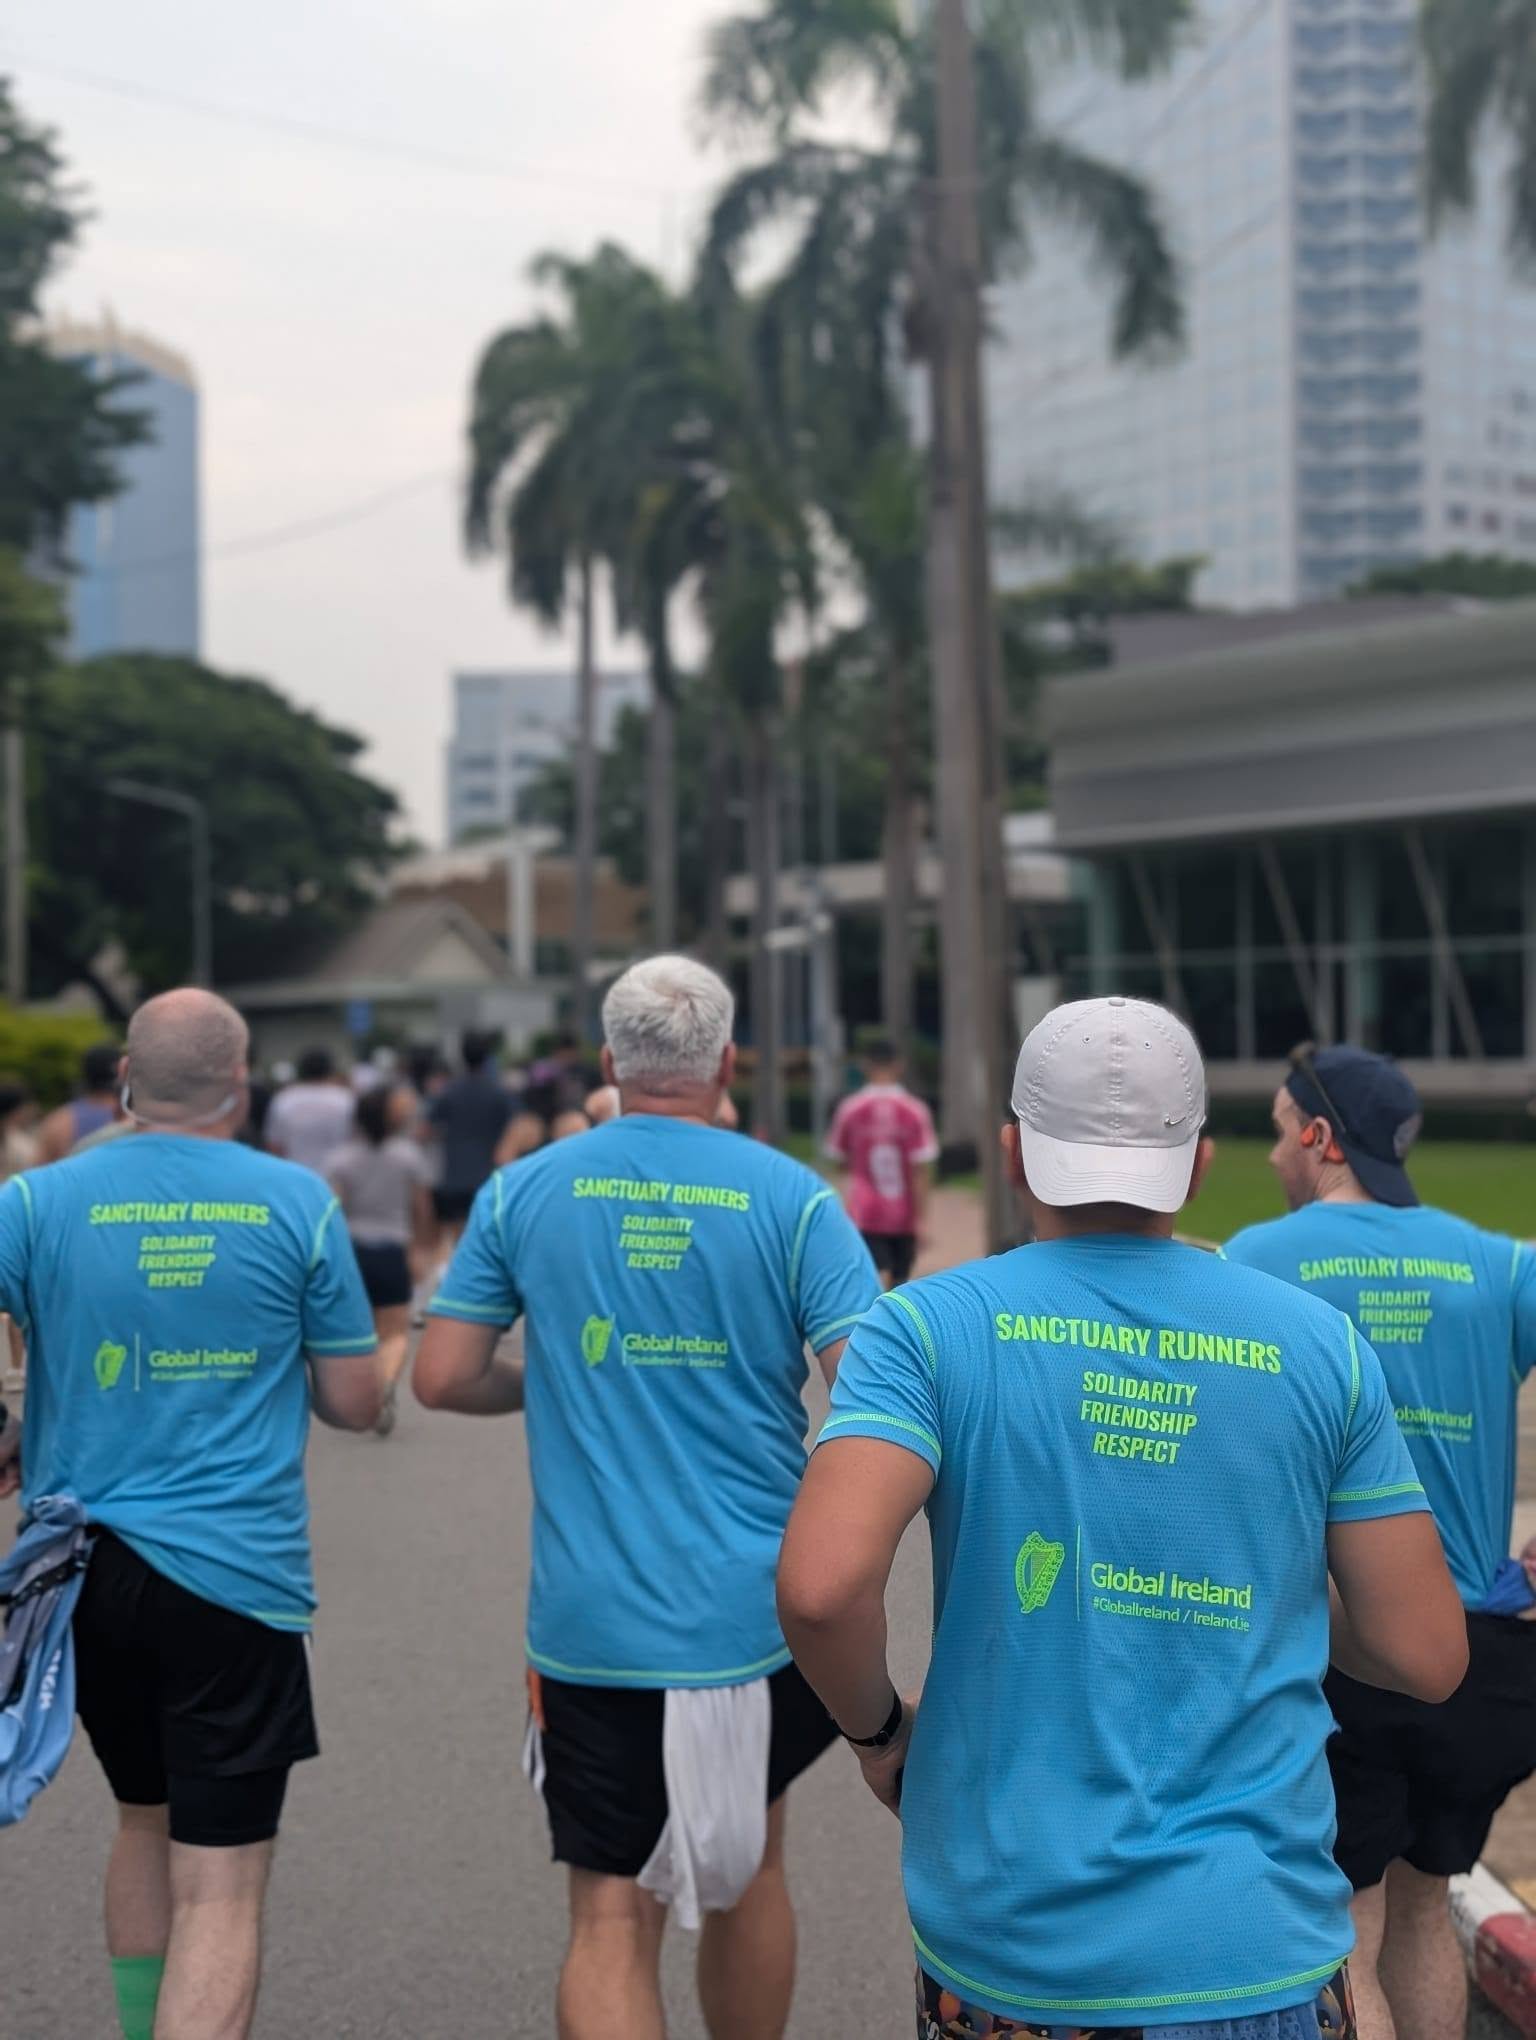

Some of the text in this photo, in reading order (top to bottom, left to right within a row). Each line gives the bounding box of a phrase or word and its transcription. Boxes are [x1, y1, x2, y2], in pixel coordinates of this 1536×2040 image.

[573, 1177, 750, 1211] SANCTUARY RUNNERS
[90, 1202, 270, 1226] SANCTUARY RUNNERS
[622, 1214, 694, 1233] SOLIDARITY
[140, 1235, 216, 1252] SOLIDARITY
[619, 1233, 692, 1251] FRIENDSHIP
[138, 1252, 216, 1270] FRIENDSHIP
[627, 1252, 681, 1270] RESPECT
[1299, 1257, 1475, 1284] SANCTUARY RUNNERS
[148, 1270, 204, 1288] RESPECT
[1358, 1290, 1431, 1306] SOLIDARITY
[1359, 1308, 1433, 1325] FRIENDSHIP
[623, 1333, 728, 1354] Global Ireland
[995, 1313, 1281, 1374] SANCTUARY RUNNERS
[1370, 1327, 1424, 1343] RESPECT
[149, 1347, 258, 1368] Global Ireland
[1082, 1371, 1198, 1406] SOLIDARITY
[1080, 1400, 1198, 1436] FRIENDSHIP
[1092, 1432, 1181, 1464] RESPECT
[1090, 1562, 1252, 1610] Global Ireland
[1093, 1595, 1180, 1622] #GlobalIreland
[1193, 1610, 1250, 1632] Ireland.ie
